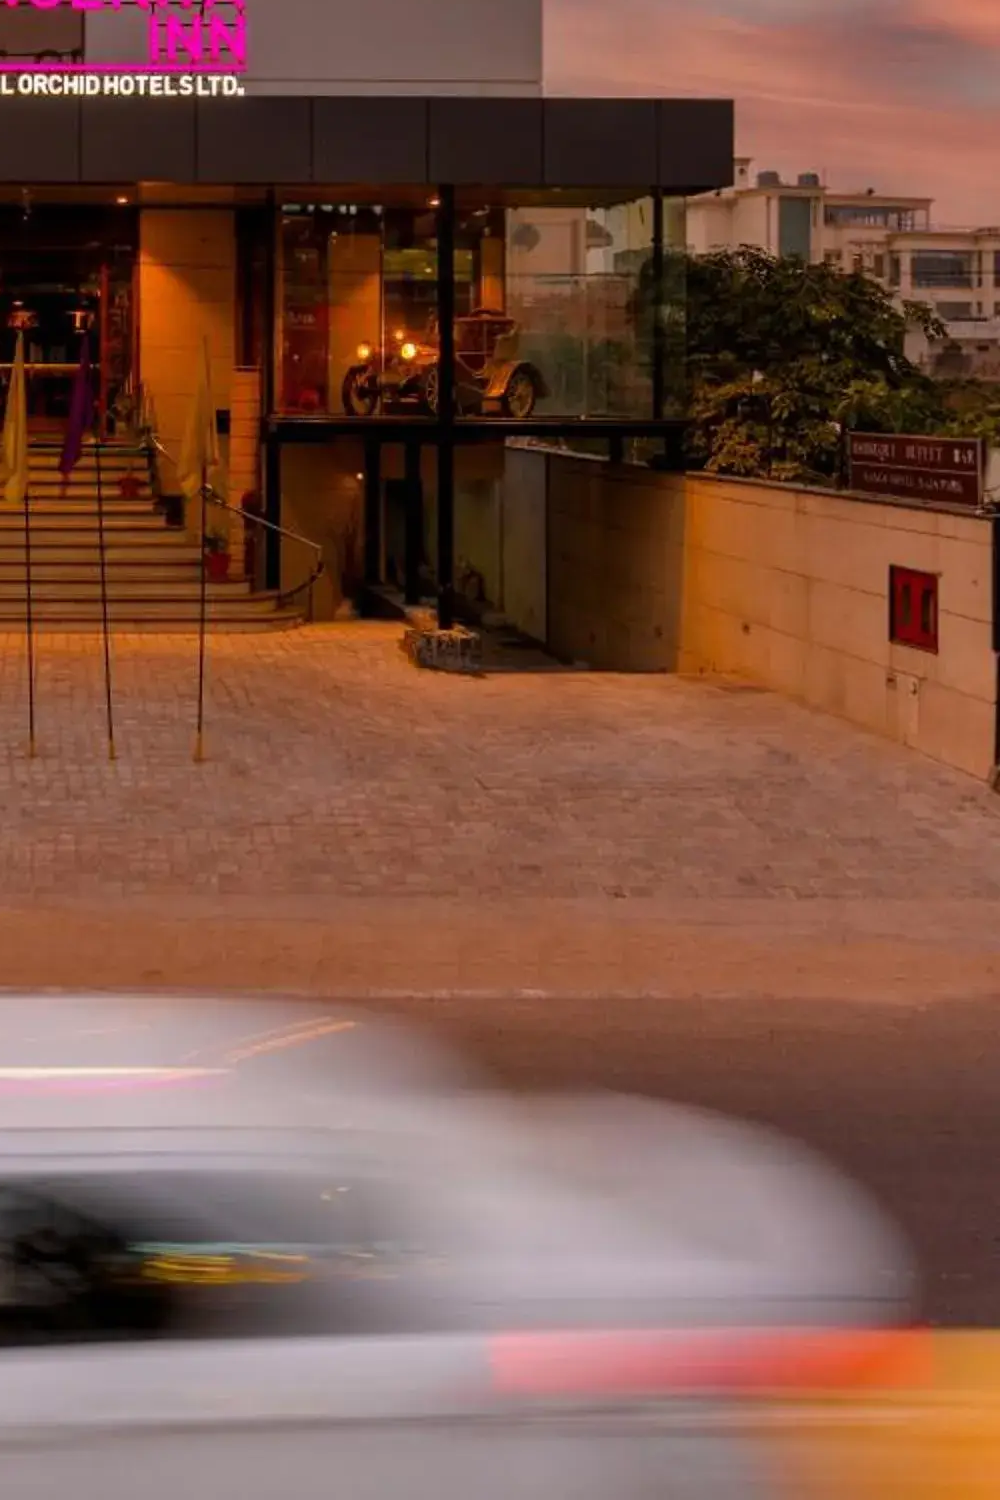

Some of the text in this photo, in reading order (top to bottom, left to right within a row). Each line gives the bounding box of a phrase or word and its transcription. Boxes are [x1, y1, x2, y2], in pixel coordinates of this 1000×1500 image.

[148, 12, 247, 66] INN
[17, 73, 101, 96] ORCHID
[103, 74, 194, 97] HOTELS
[196, 74, 246, 97] LTD.
